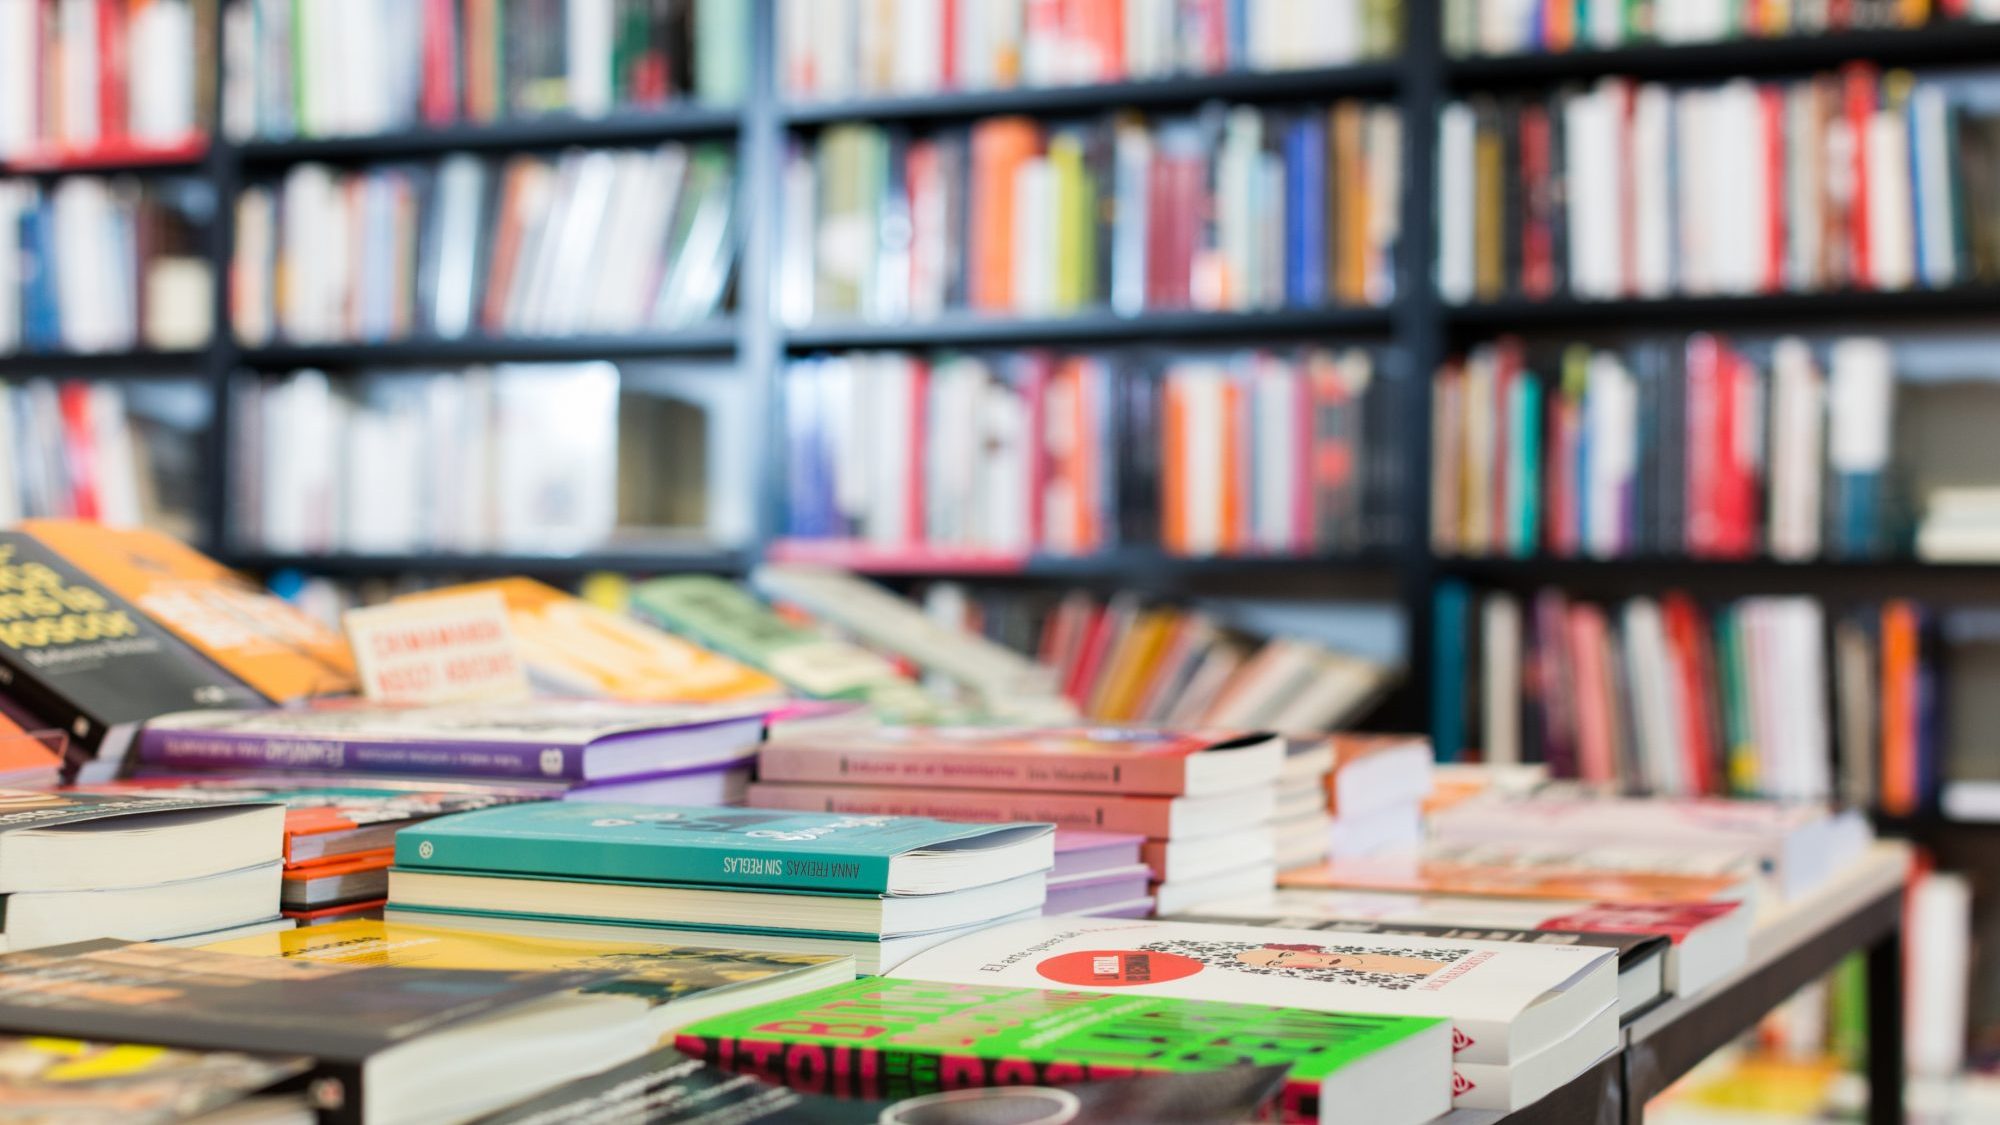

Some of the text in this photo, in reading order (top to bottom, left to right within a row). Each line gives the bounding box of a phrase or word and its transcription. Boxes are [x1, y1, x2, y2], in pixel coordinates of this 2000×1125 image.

[723, 857, 860, 878] ANNA FREIXAS SIN REGLAS
[980, 962, 1006, 974] El
